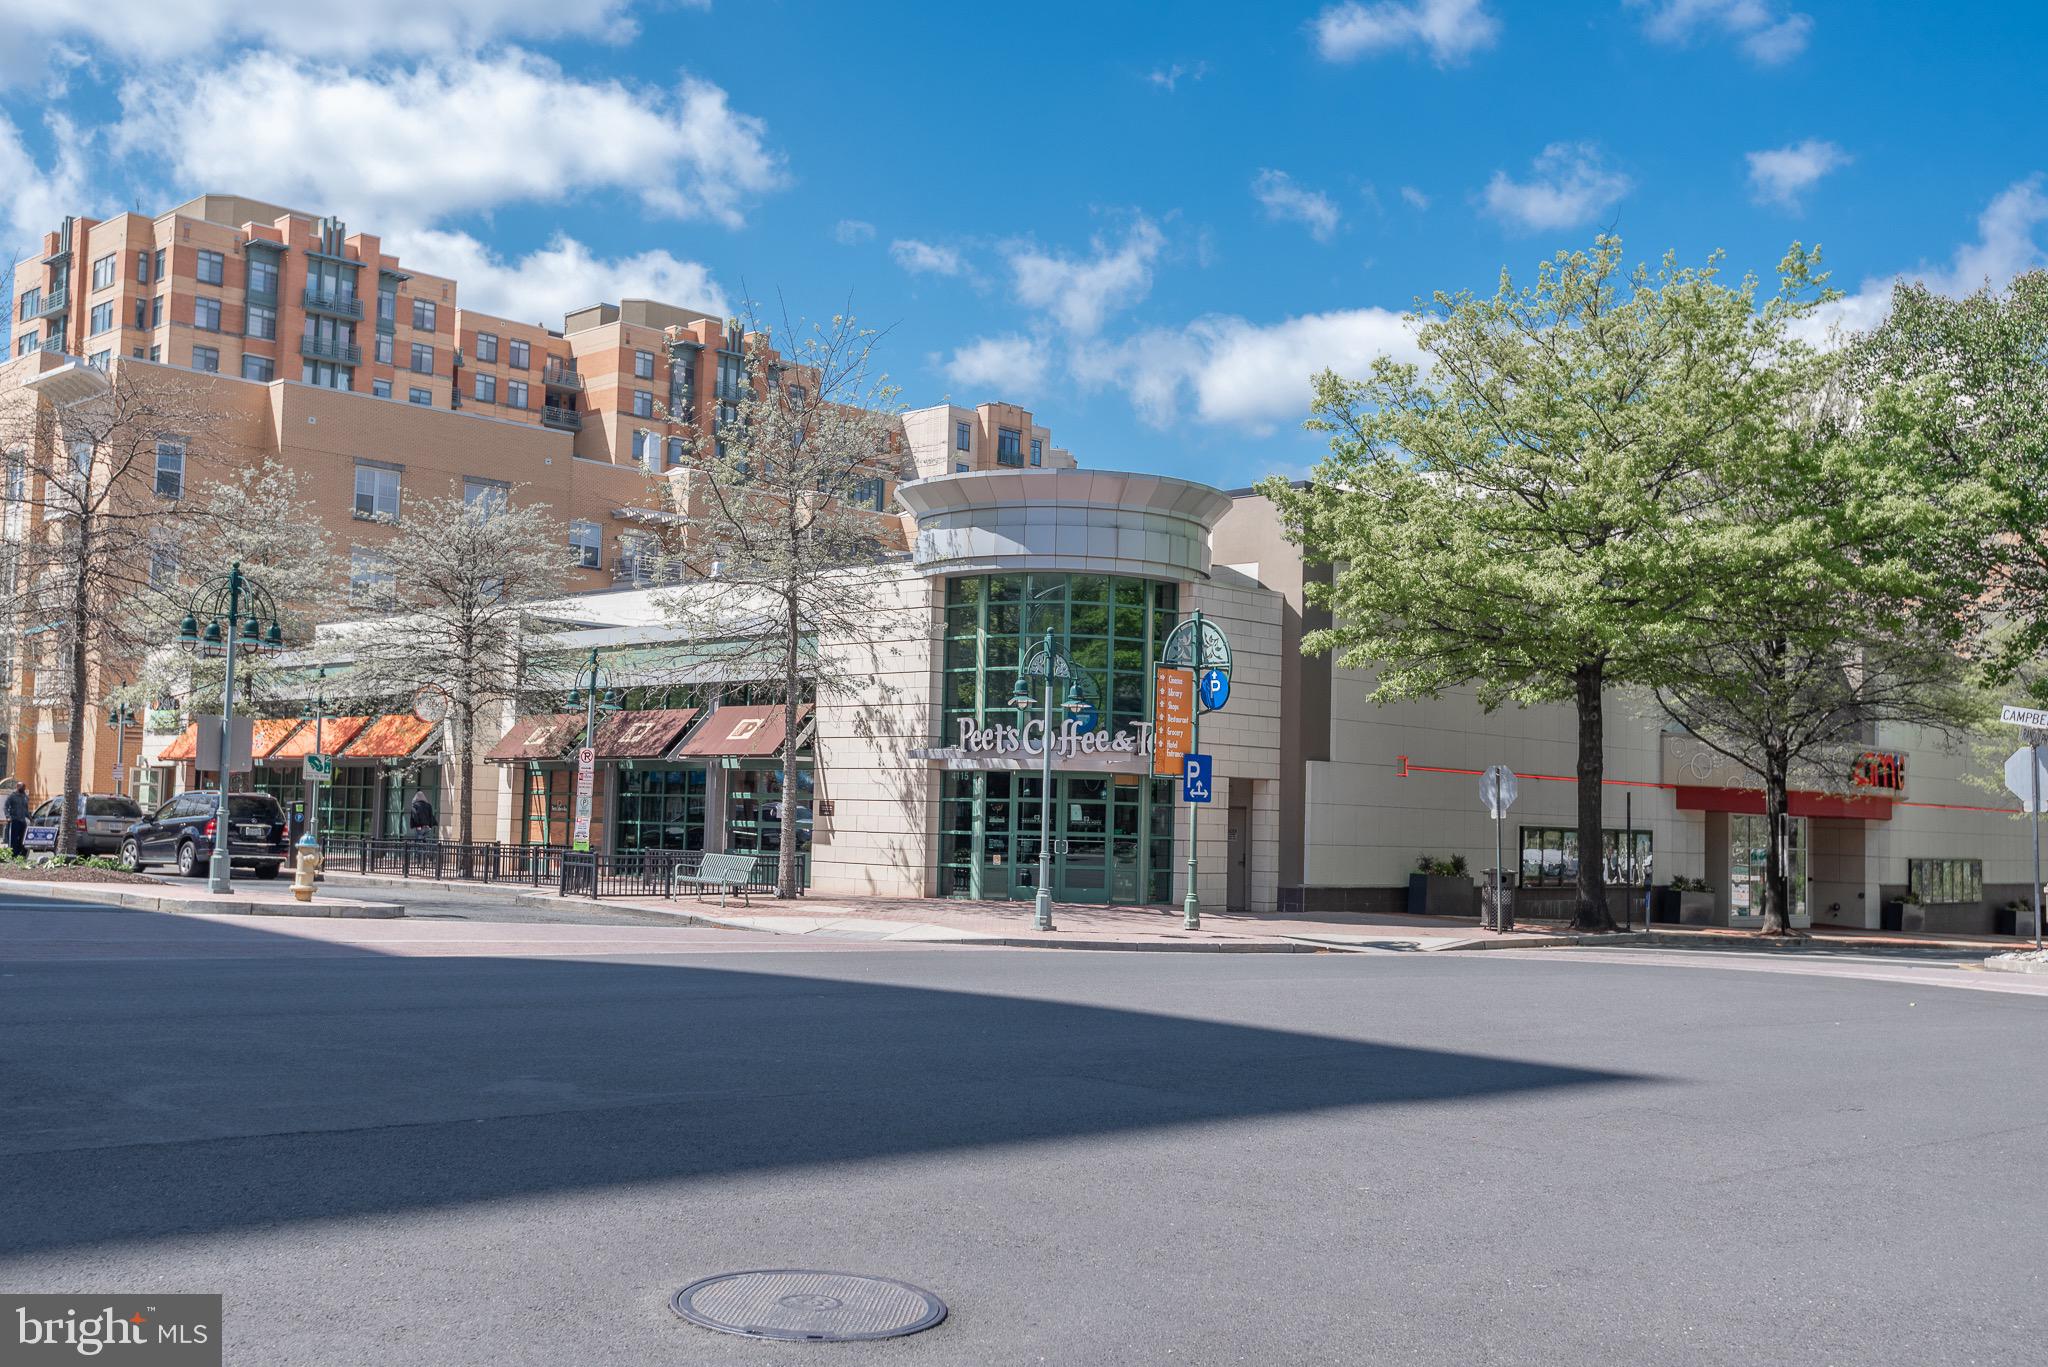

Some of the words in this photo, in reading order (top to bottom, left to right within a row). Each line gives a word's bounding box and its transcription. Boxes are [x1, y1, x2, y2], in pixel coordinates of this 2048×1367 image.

[1167, 687, 1183, 699] Library
[1167, 700, 1180, 712] Shops
[1167, 713, 1189, 724] Restaurant
[956, 717, 1020, 754] Peet's
[1111, 730, 1136, 752] &
[1166, 726, 1184, 738] Grocery
[1166, 739, 1178, 749] Hotel
[951, 771, 969, 780] 4115
[1187, 760, 1200, 788] P
